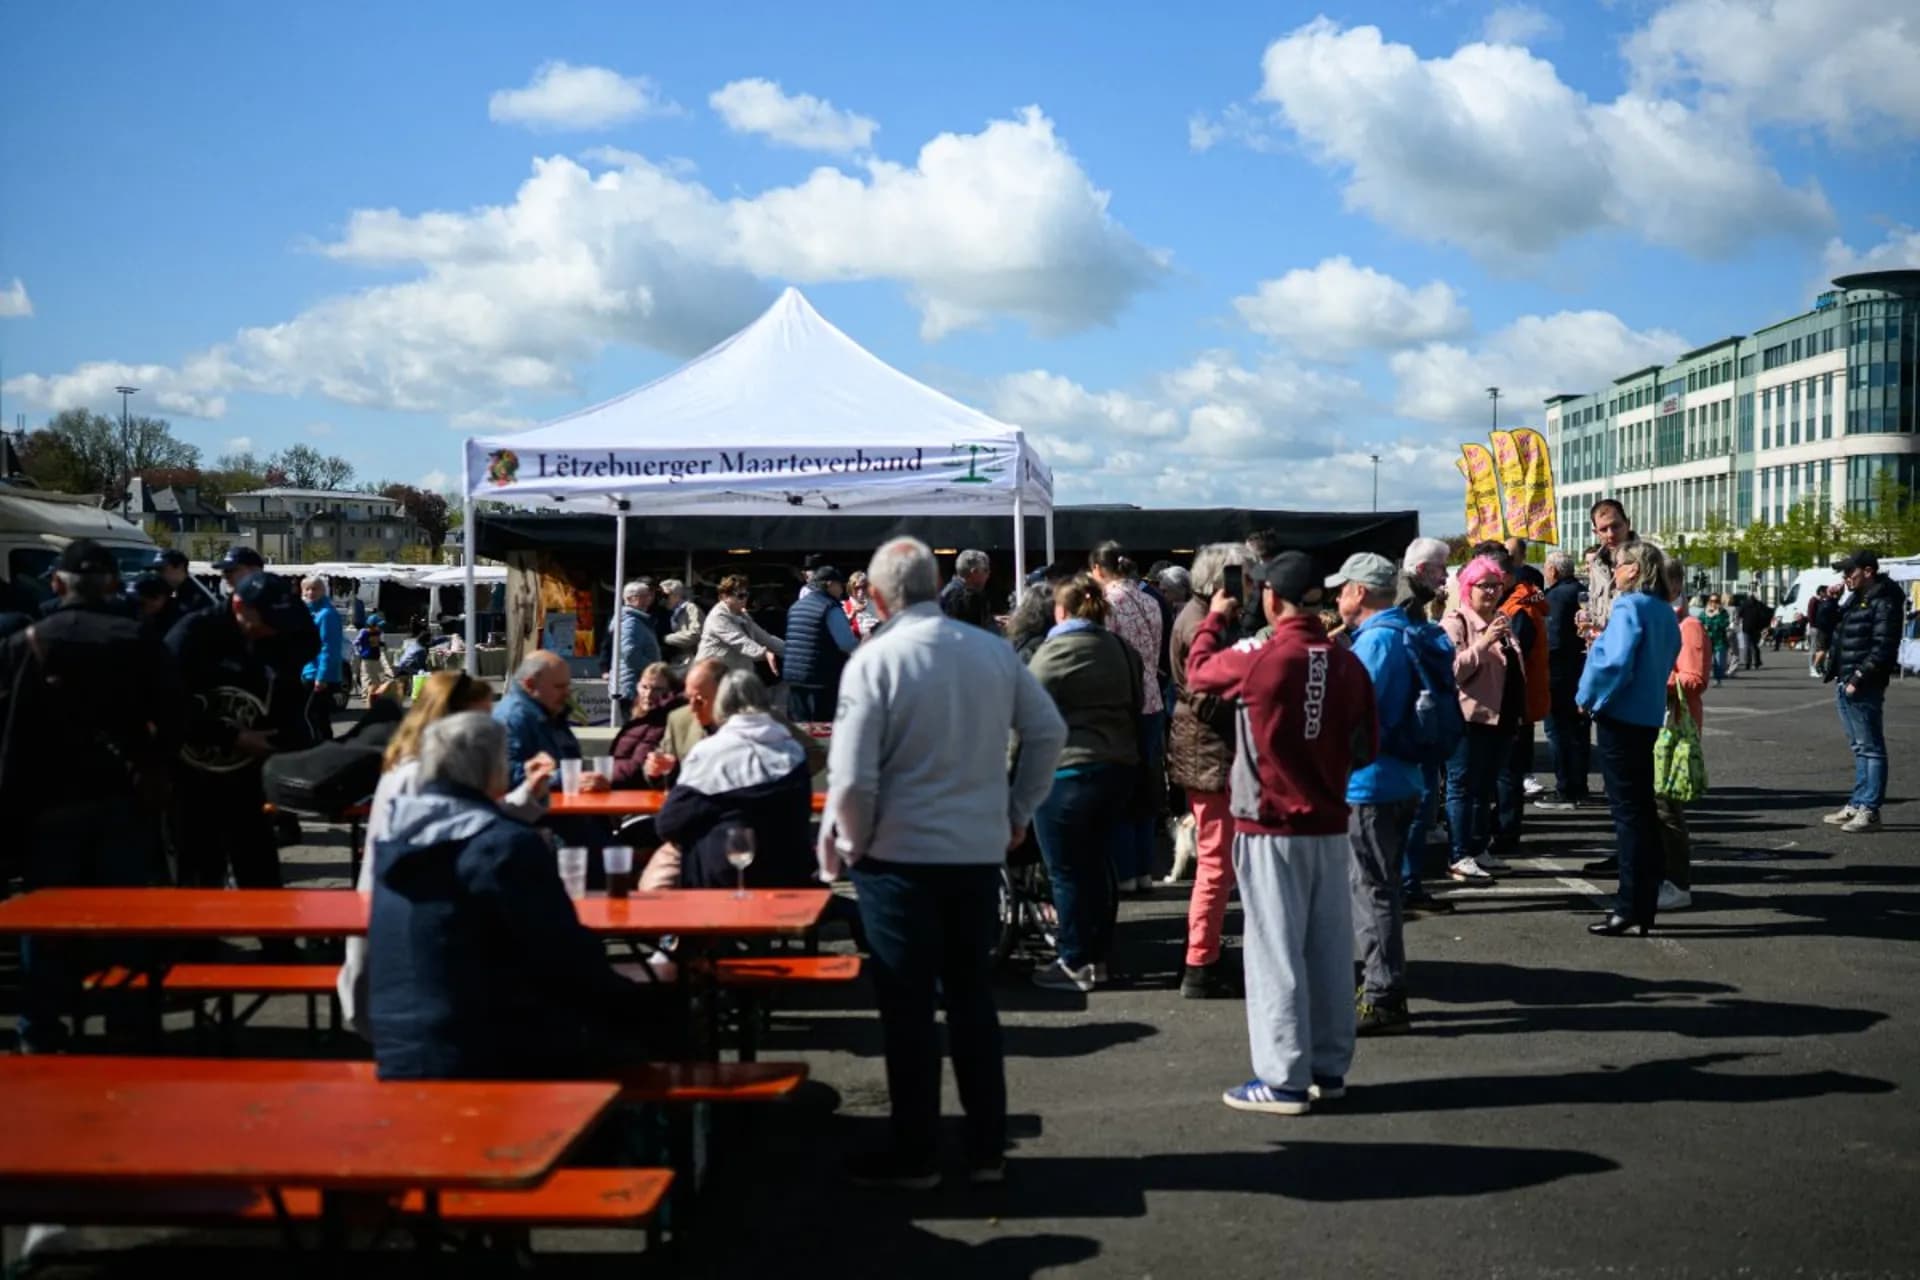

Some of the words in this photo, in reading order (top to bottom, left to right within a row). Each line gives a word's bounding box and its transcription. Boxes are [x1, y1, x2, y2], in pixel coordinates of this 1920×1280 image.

[538, 452, 712, 483] Lëtzebuerger
[719, 448, 923, 474] Maarteverband
[1304, 647, 1329, 740] Kappa
